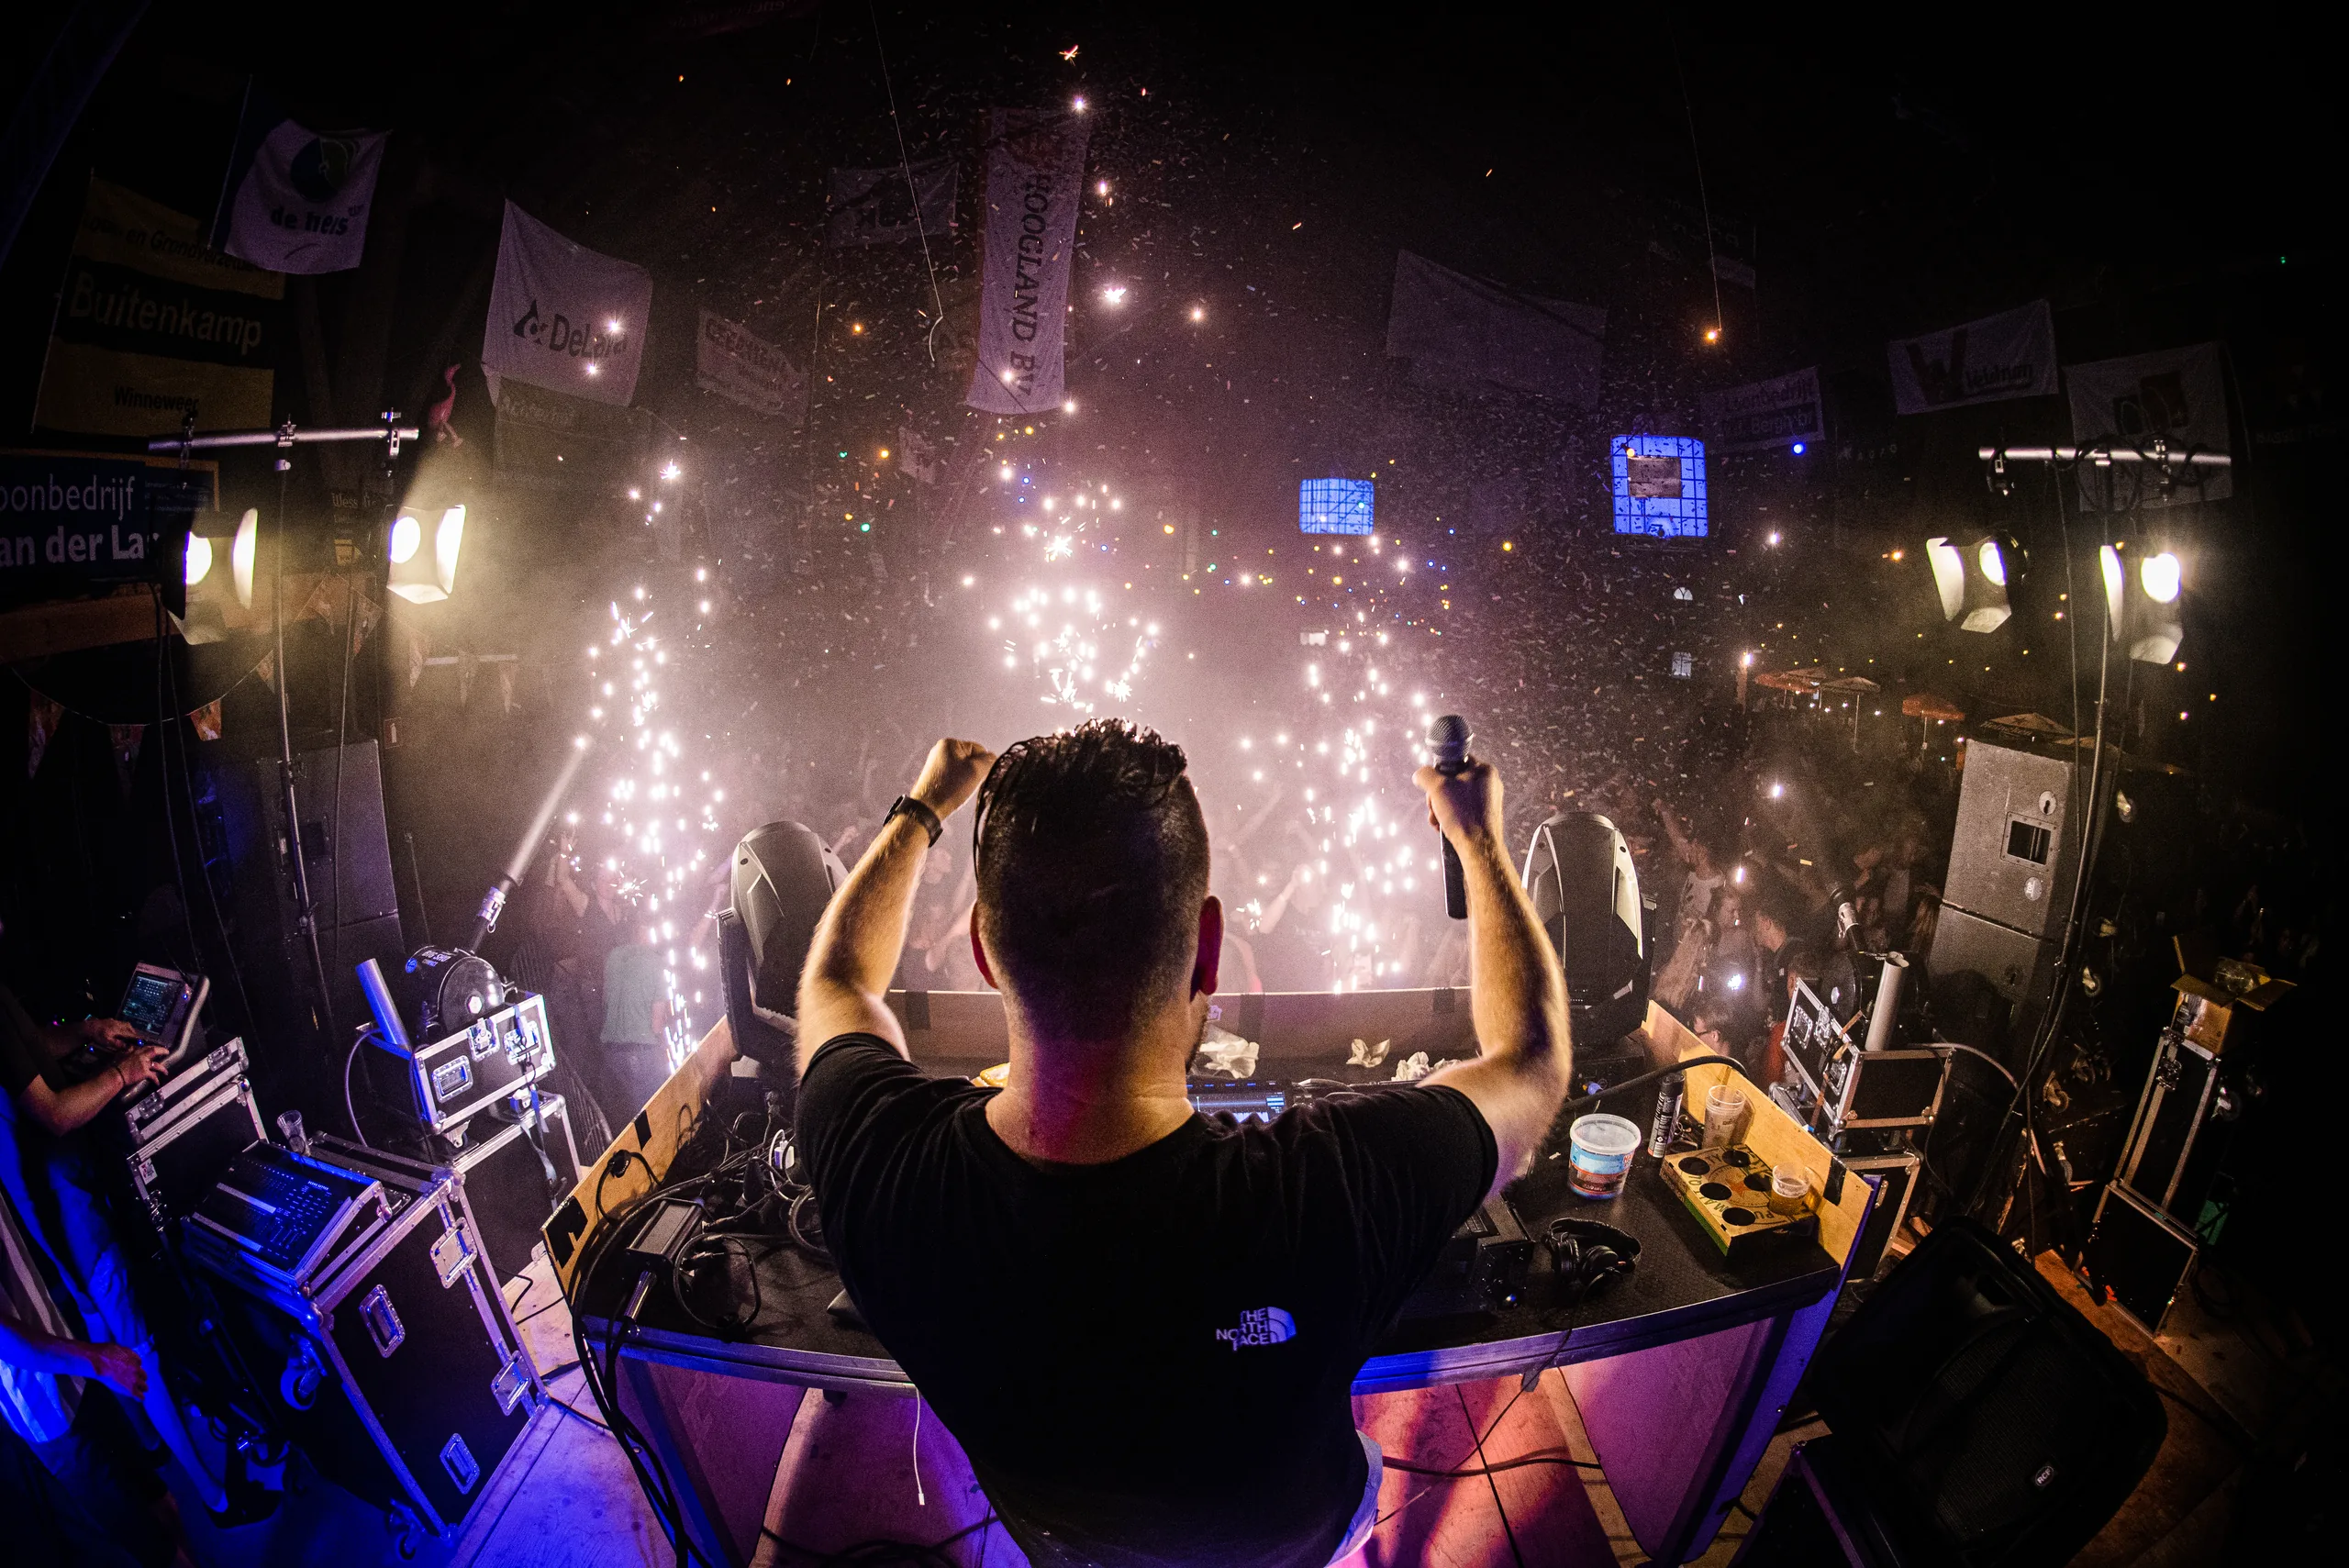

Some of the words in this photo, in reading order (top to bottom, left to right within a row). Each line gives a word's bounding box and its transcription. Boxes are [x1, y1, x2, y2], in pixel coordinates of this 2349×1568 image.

[271, 206, 297, 229] de
[126, 228, 147, 248] en
[1011, 172, 1052, 343] HOOGLAND
[69, 270, 262, 356] Buitenkamp
[115, 385, 199, 413] Winneweer
[0, 534, 36, 568] an
[46, 525, 104, 563] der
[1240, 1307, 1267, 1323] THE
